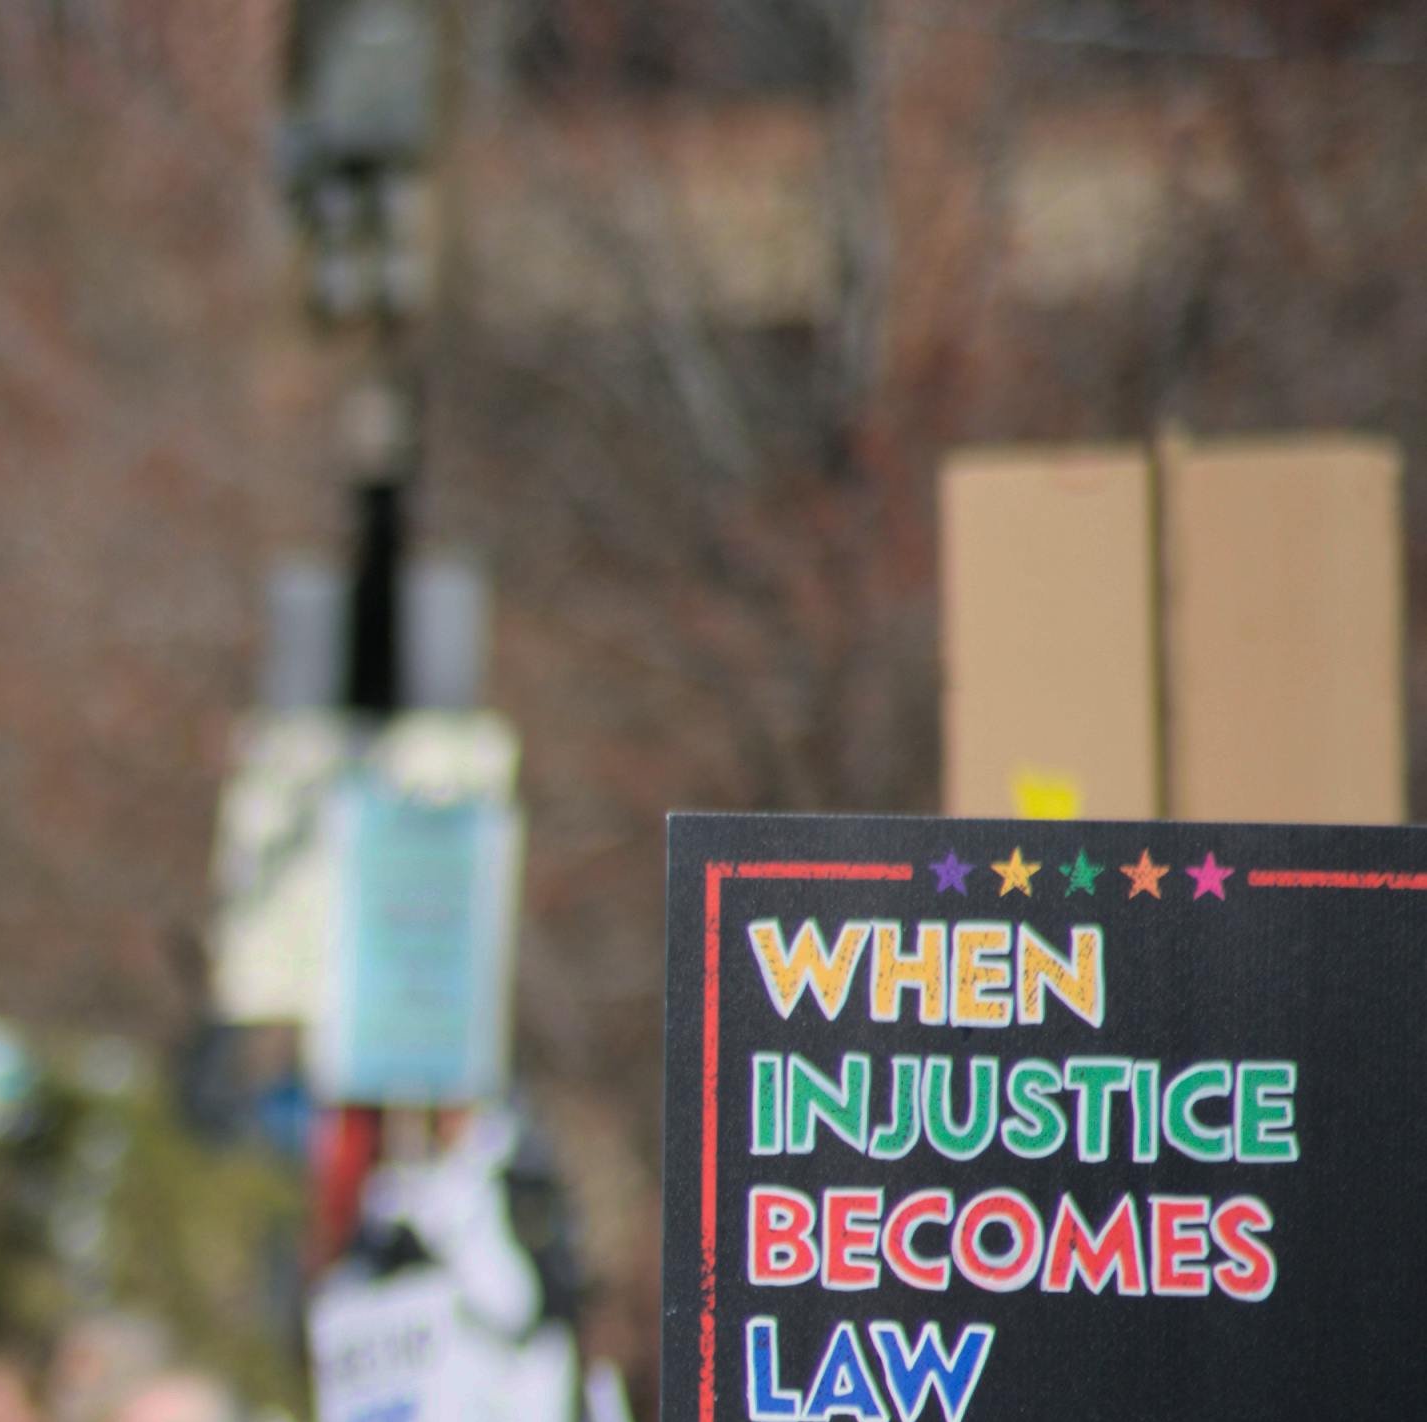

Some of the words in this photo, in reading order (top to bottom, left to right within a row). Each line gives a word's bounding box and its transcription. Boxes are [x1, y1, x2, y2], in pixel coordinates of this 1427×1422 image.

[745, 917, 1106, 1030] WHEN
[747, 1050, 1301, 1164] INJUSTICE
[745, 1184, 1278, 1303] BECOMES
